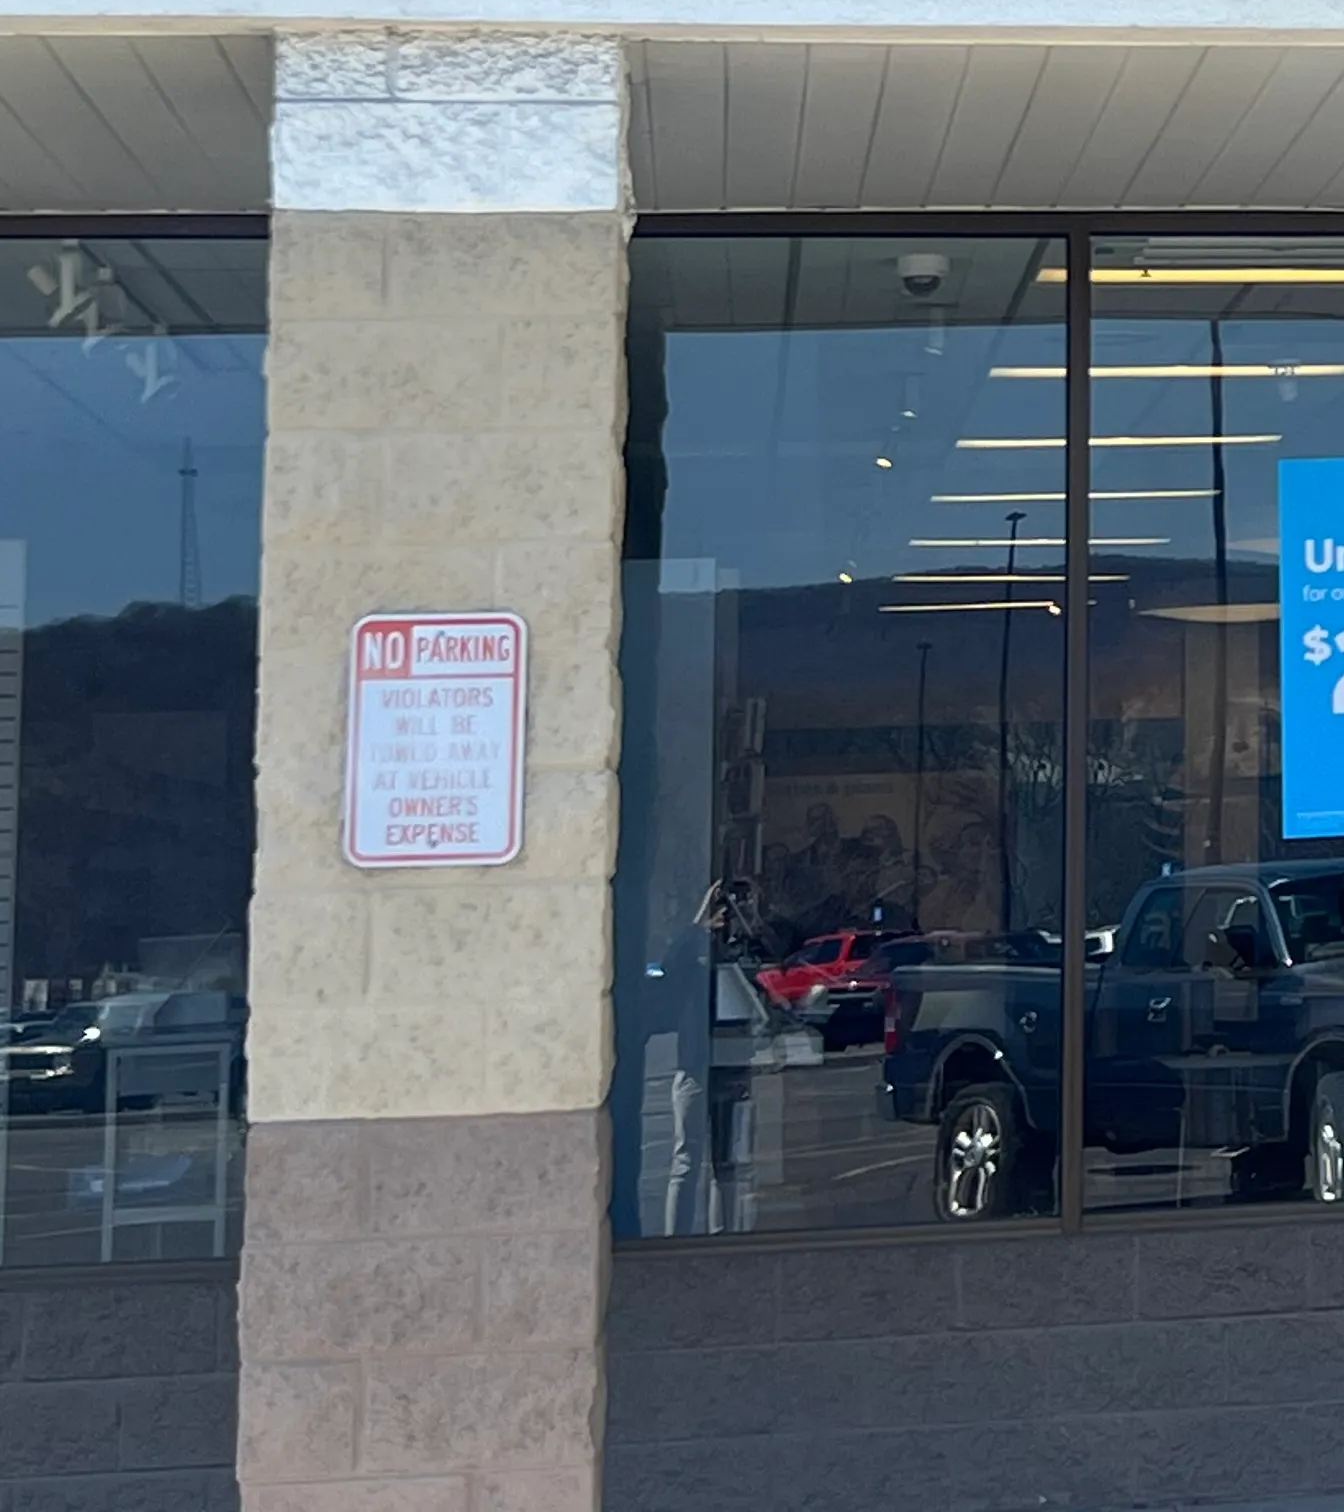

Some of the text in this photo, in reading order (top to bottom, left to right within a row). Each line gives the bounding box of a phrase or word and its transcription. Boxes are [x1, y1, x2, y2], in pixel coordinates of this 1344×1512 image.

[1302, 584, 1326, 602] for
[362, 631, 511, 670] NO PARKING
[382, 688, 493, 709] VIOLATORS
[395, 715, 477, 736] WILL BE
[371, 769, 493, 791] AT VEHICLE
[388, 796, 479, 818] OWNER'S
[385, 822, 480, 846] EXPENSE
